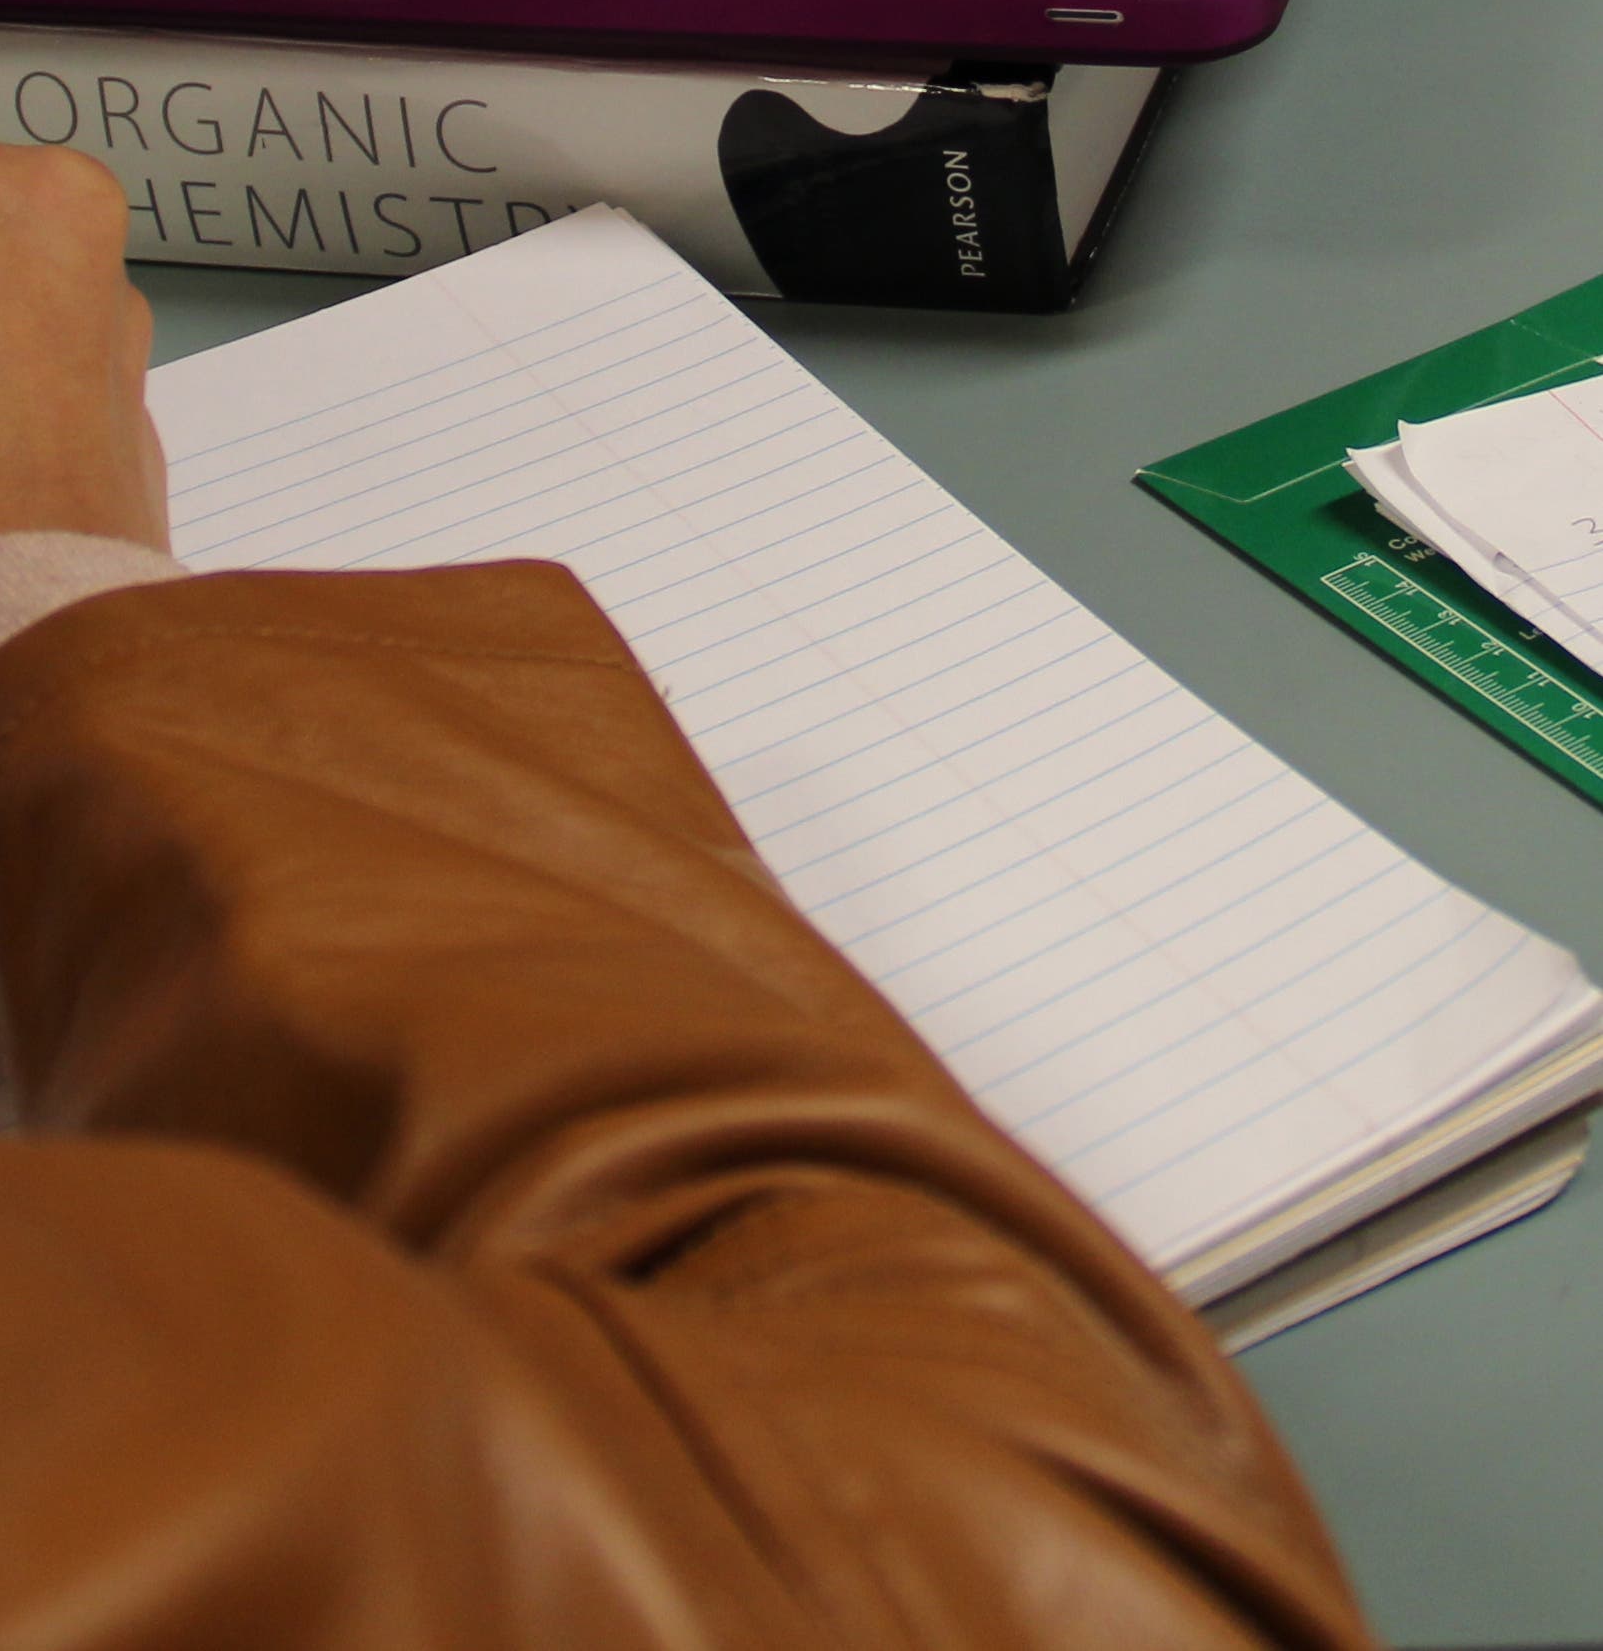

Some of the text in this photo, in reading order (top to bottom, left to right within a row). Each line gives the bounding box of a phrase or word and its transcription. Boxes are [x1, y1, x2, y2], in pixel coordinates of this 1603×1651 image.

[14, 70, 497, 174] ORGANIC
[127, 177, 577, 257] HEMIST
[942, 149, 986, 278] PEARSON
